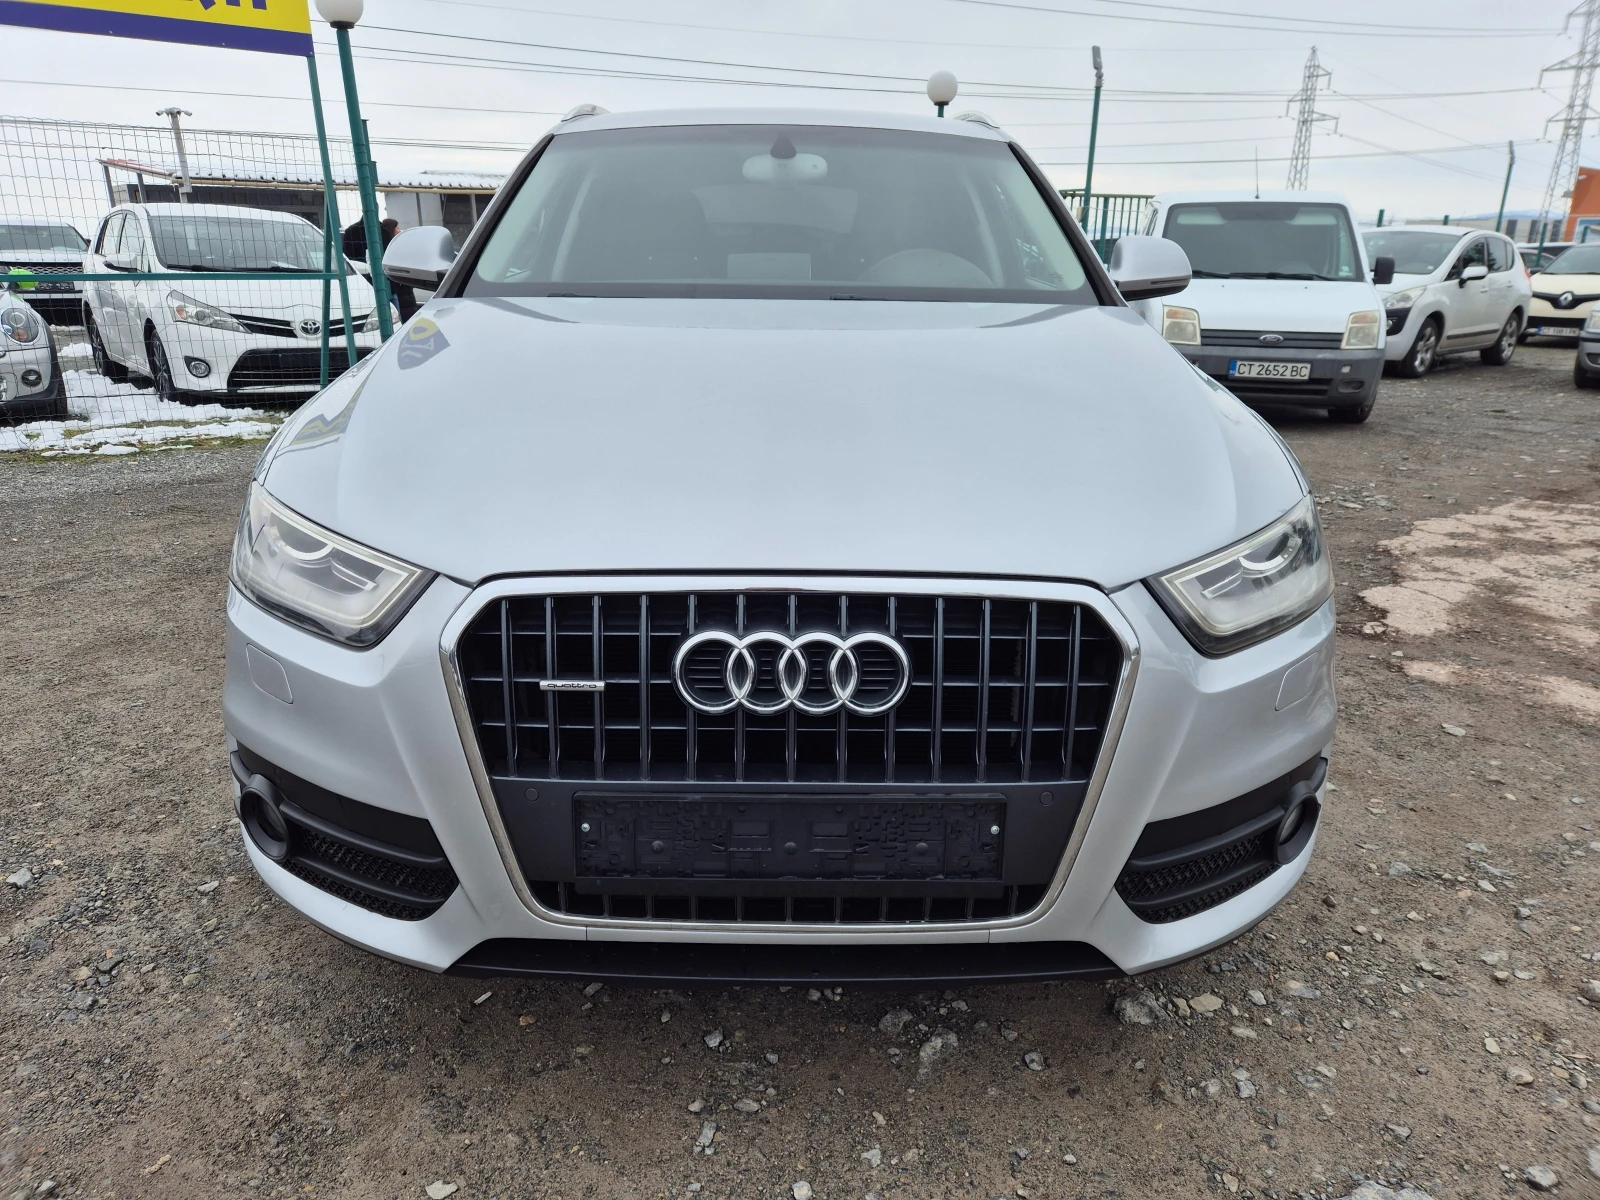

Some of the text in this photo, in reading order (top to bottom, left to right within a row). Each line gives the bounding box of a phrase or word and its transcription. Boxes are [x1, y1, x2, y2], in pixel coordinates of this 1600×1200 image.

[1237, 363, 1255, 375] CT
[1256, 364, 1288, 377] 2652
[1290, 365, 1308, 378] BC
